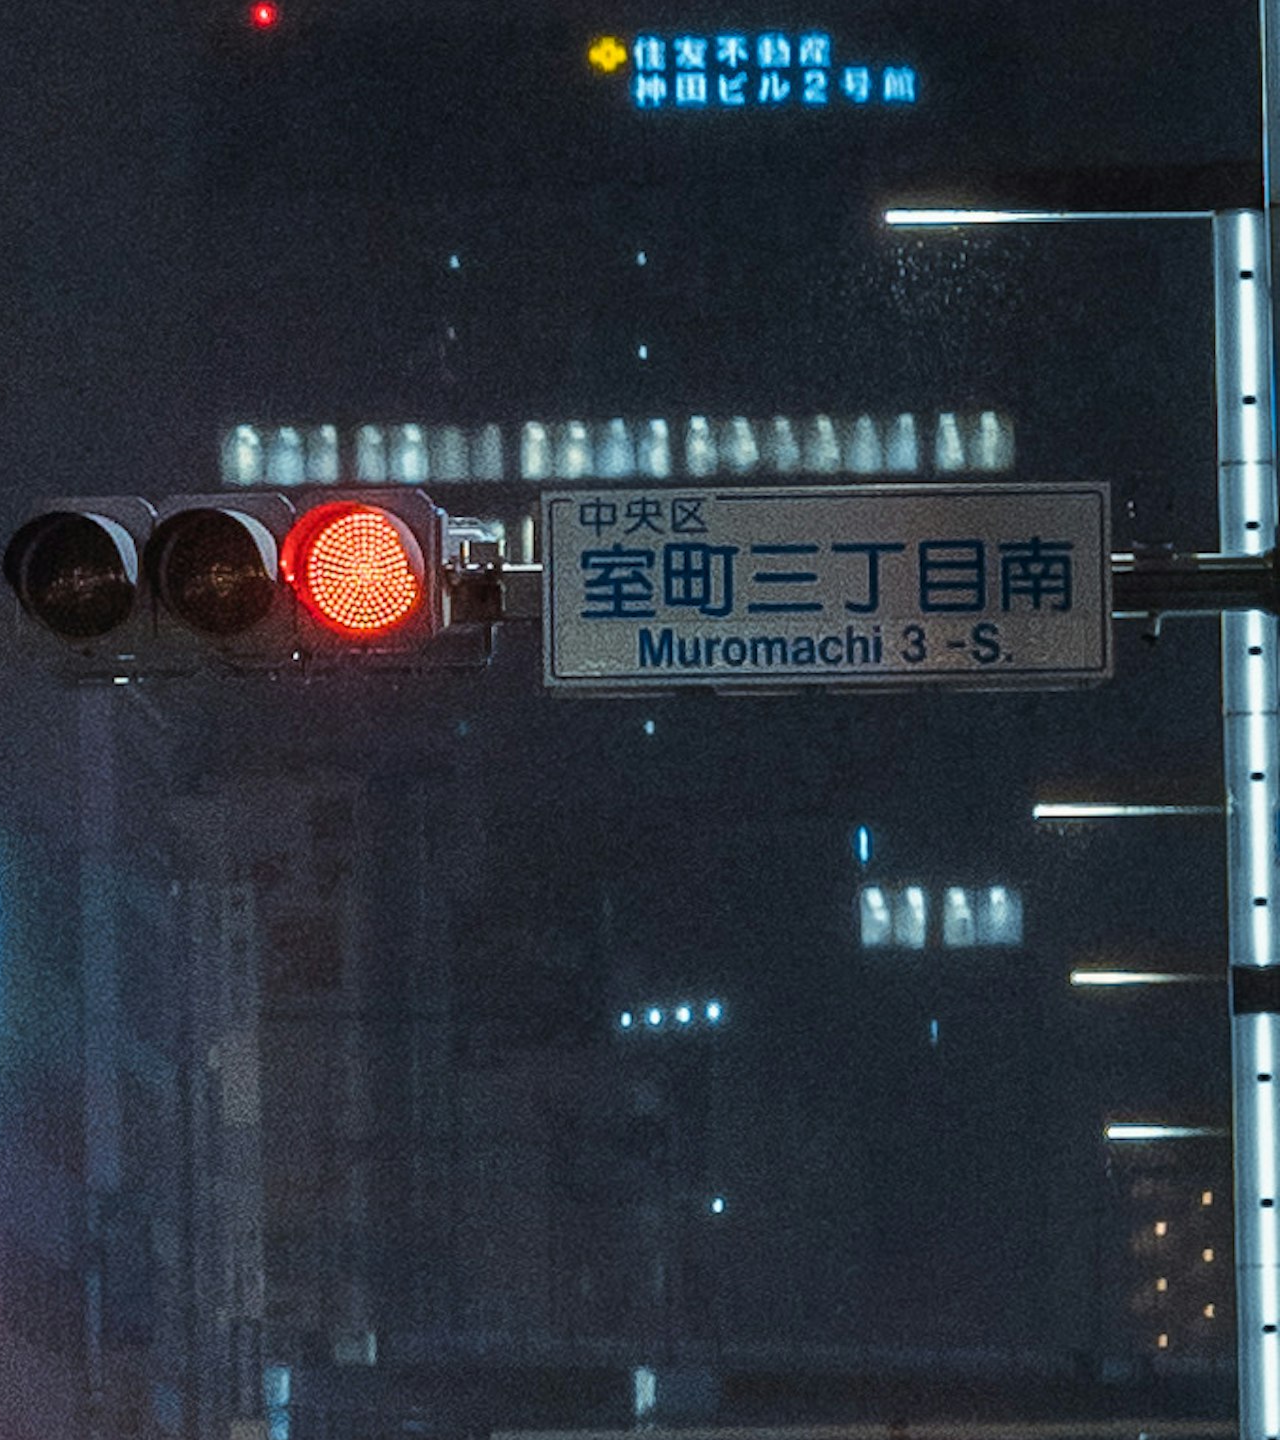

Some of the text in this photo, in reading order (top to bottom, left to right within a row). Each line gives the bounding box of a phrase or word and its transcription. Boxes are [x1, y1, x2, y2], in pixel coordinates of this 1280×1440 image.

[578, 497, 708, 535] 中央区
[579, 537, 1074, 618] 室町三丁目南
[639, 624, 882, 668] Muromachi
